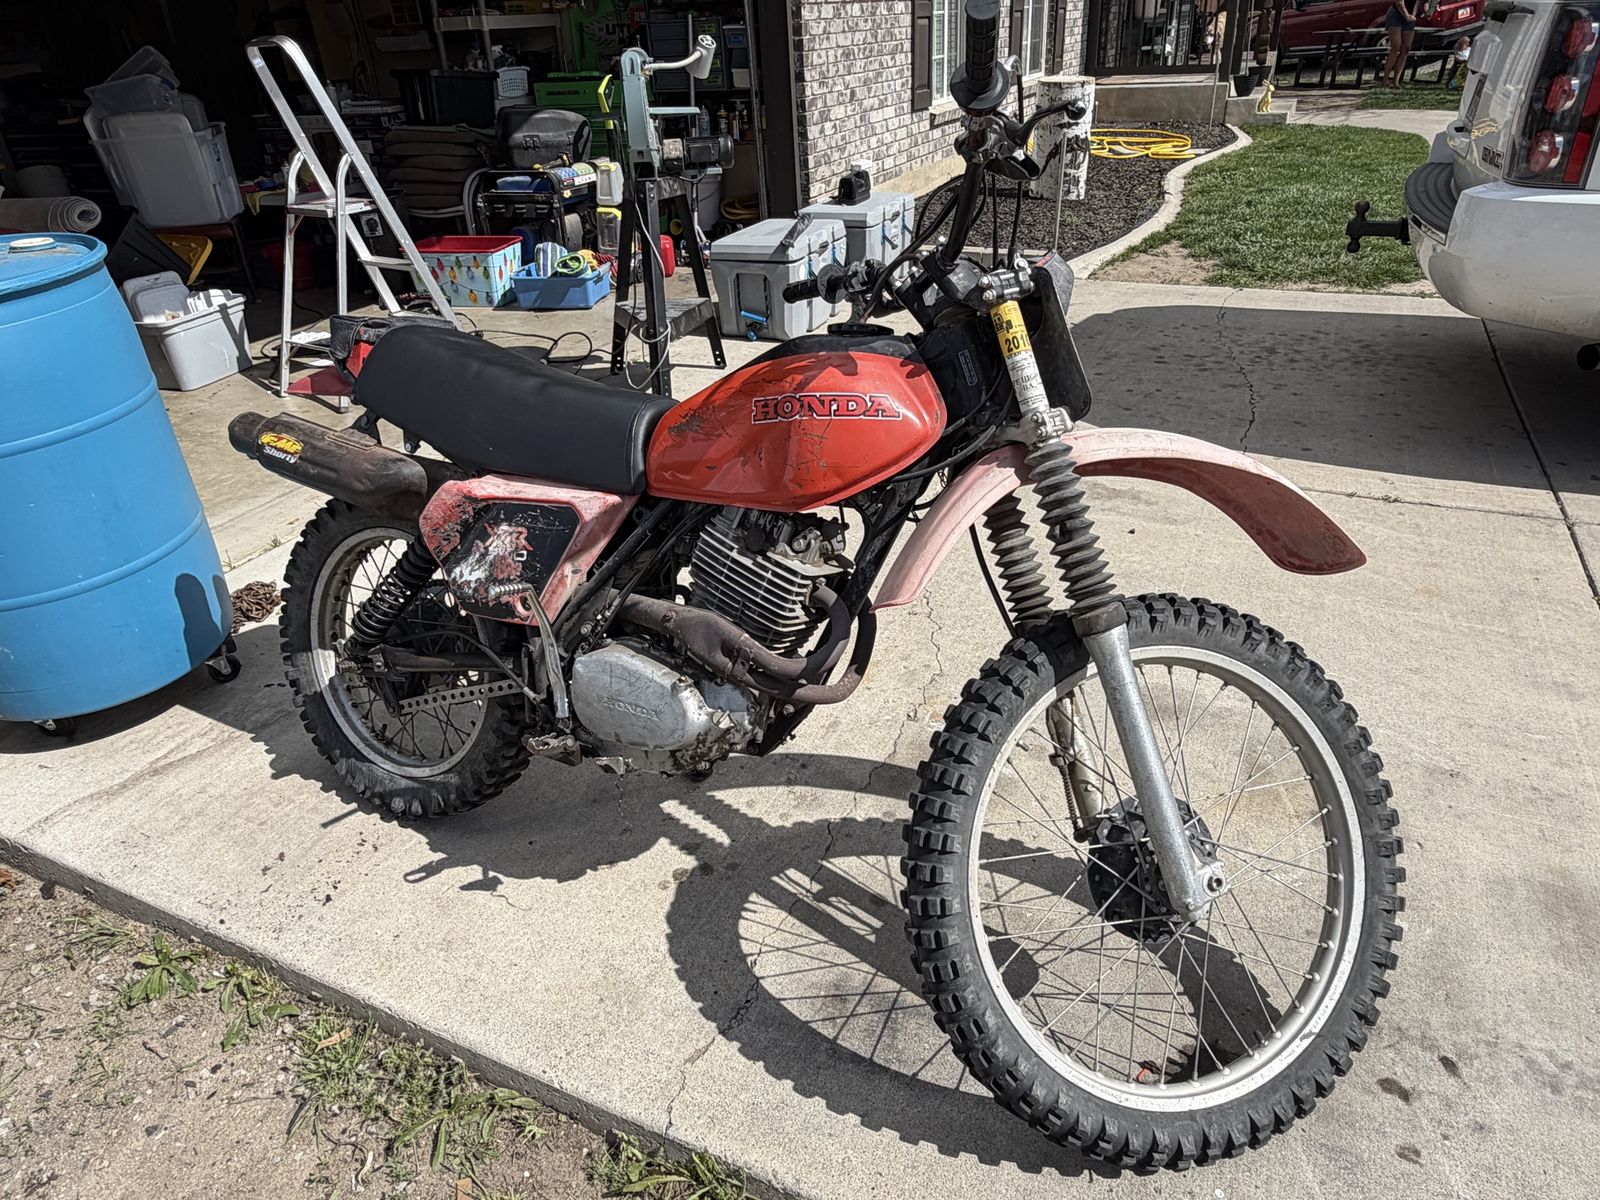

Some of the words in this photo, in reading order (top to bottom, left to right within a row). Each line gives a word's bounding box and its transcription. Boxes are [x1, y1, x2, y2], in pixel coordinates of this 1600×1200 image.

[1481, 145, 1504, 169] GMC
[752, 393, 903, 424] HONDA
[259, 433, 302, 454] FMF
[602, 696, 660, 722] HONDA
